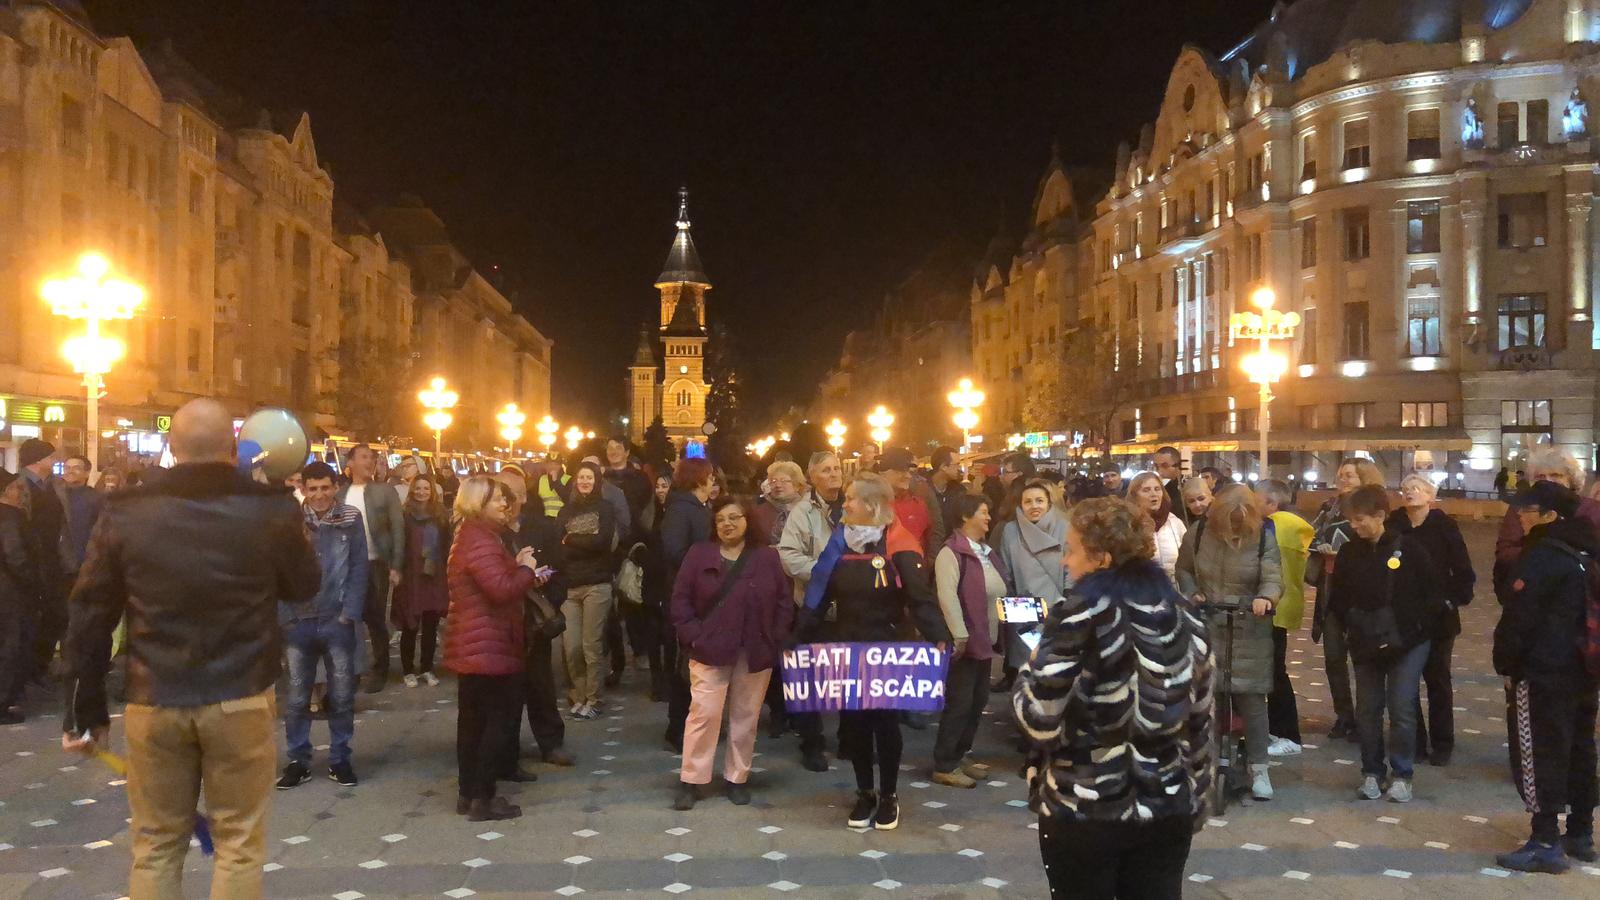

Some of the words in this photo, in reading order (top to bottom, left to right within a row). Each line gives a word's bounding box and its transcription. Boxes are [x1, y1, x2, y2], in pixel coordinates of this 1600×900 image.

[866, 647, 945, 666] GAZAT
[783, 681, 809, 701] NU
[869, 675, 944, 698] SCĂPA
